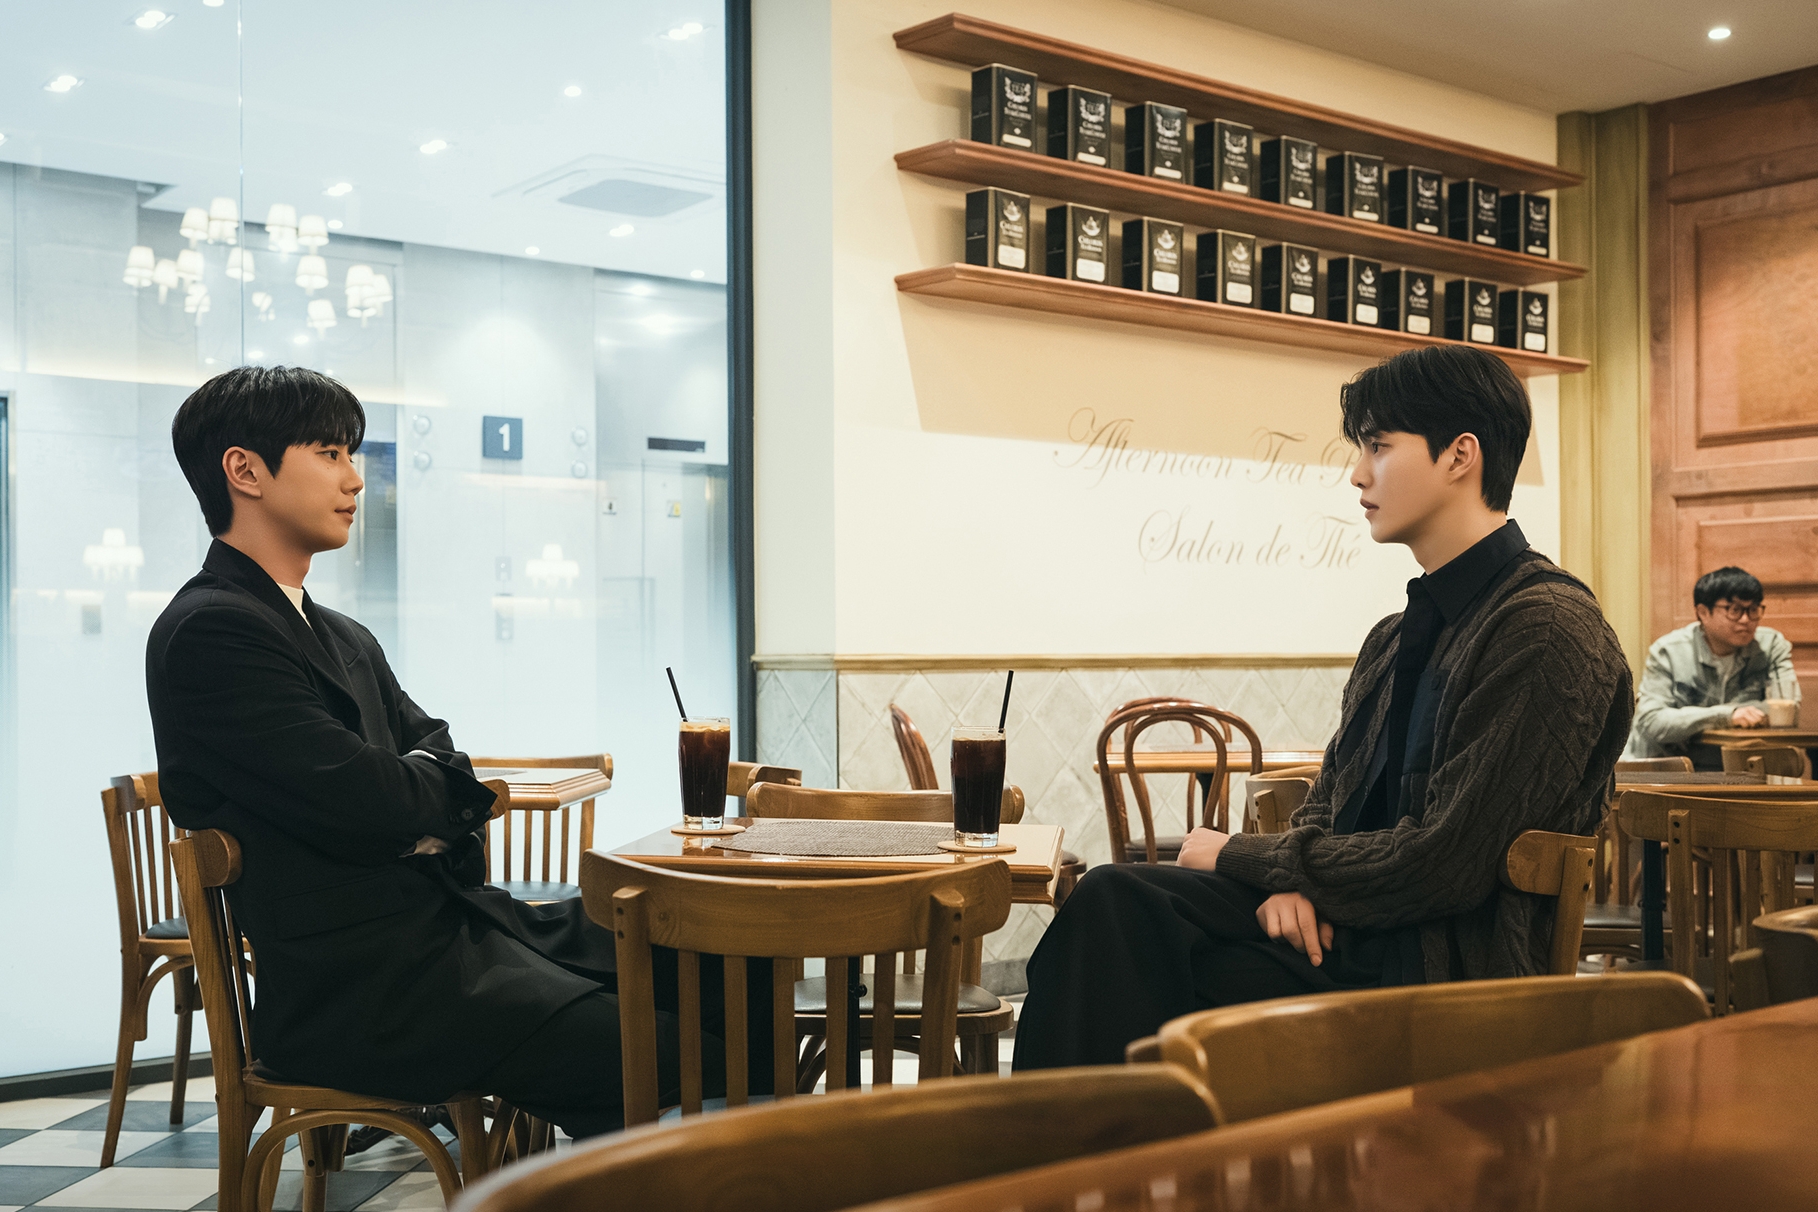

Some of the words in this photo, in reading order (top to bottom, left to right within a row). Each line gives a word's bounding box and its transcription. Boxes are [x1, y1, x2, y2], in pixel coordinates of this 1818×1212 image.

[499, 424, 510, 451] 1
[1053, 406, 1233, 489] Afternoon
[1245, 426, 1309, 485] Tea
[1138, 504, 1245, 575] Salon
[1256, 523, 1291, 567] de
[1299, 511, 1362, 571] Thé
